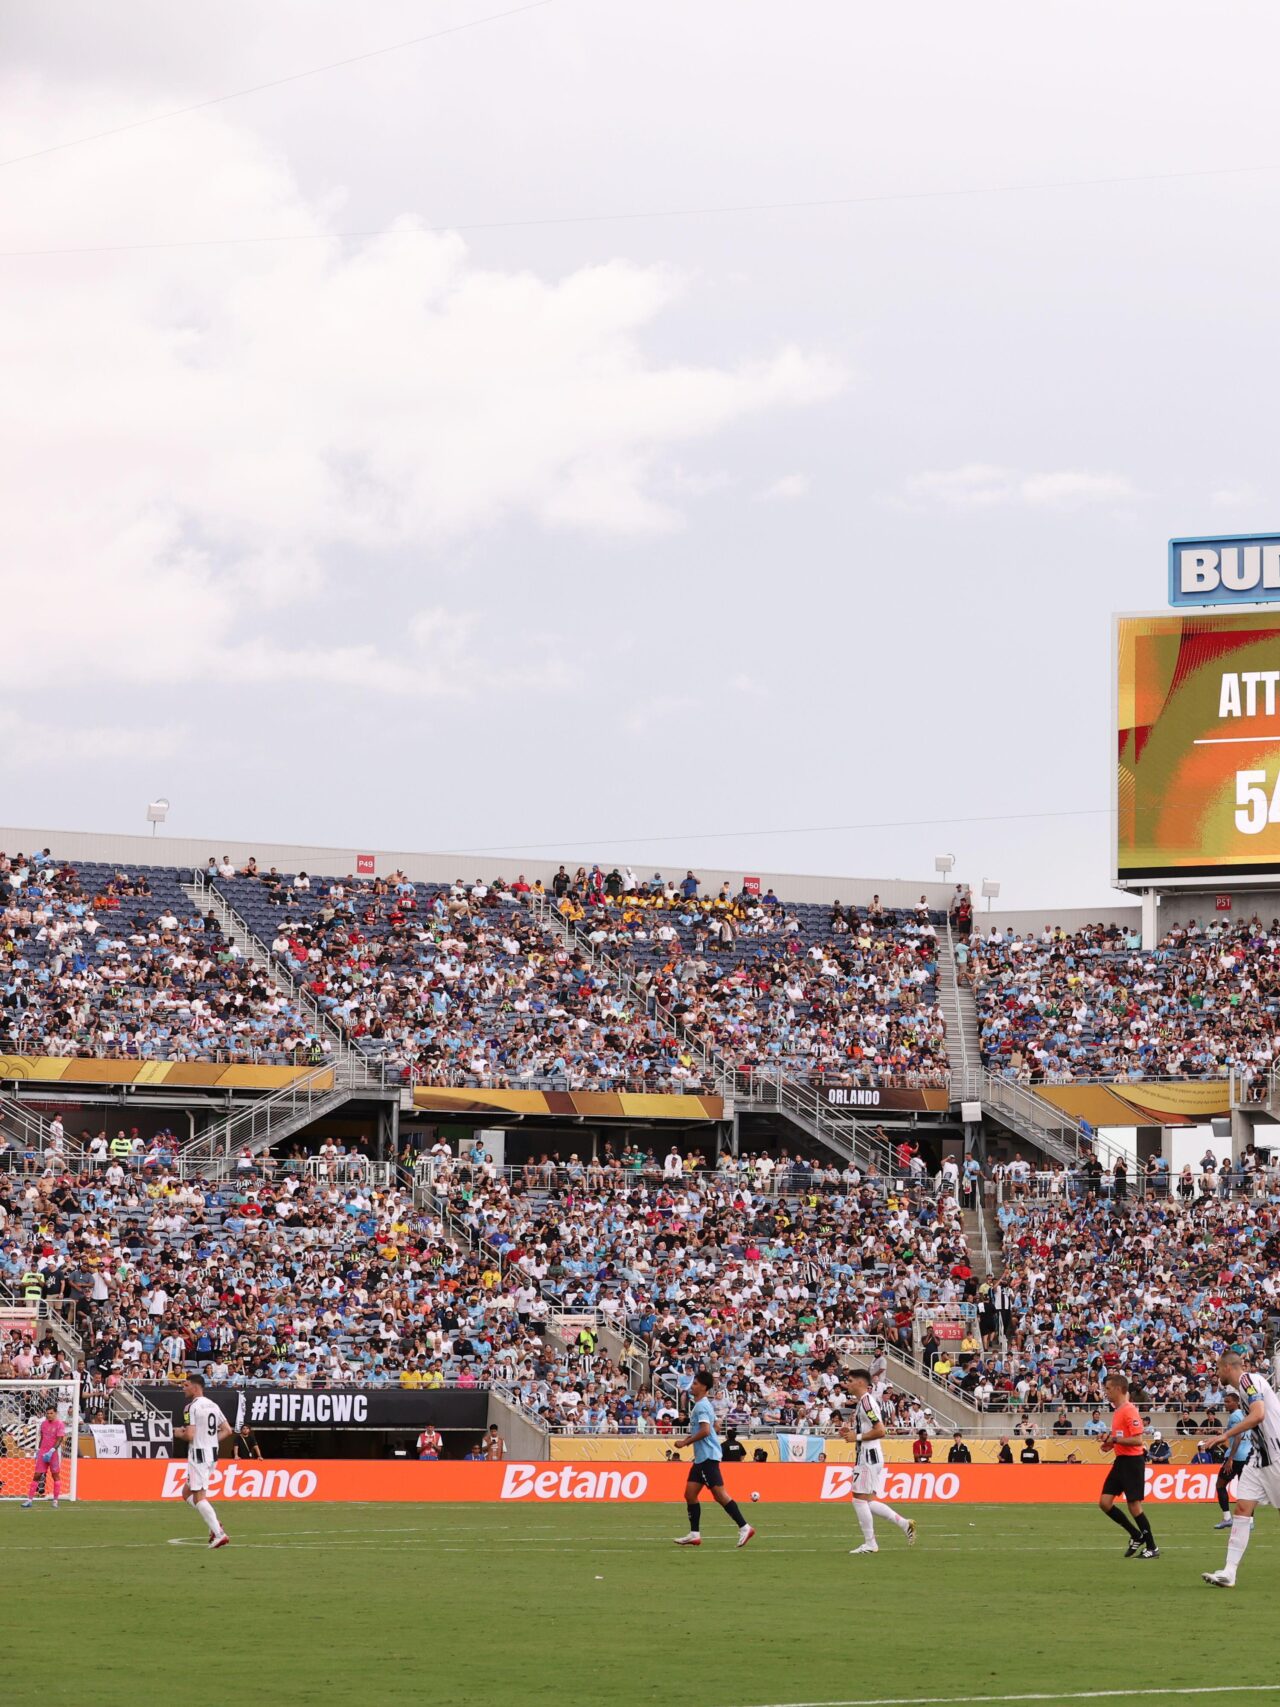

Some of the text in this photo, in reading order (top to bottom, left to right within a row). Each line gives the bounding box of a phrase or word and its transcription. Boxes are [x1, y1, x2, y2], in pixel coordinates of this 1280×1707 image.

[1217, 899, 1230, 907] P51
[828, 1089, 880, 1105] ORLANDO
[251, 1394, 368, 1422] #FIFACWC
[207, 1413, 217, 1436] 9
[501, 1464, 648, 1498] Betano
[820, 1465, 960, 1500] Btano
